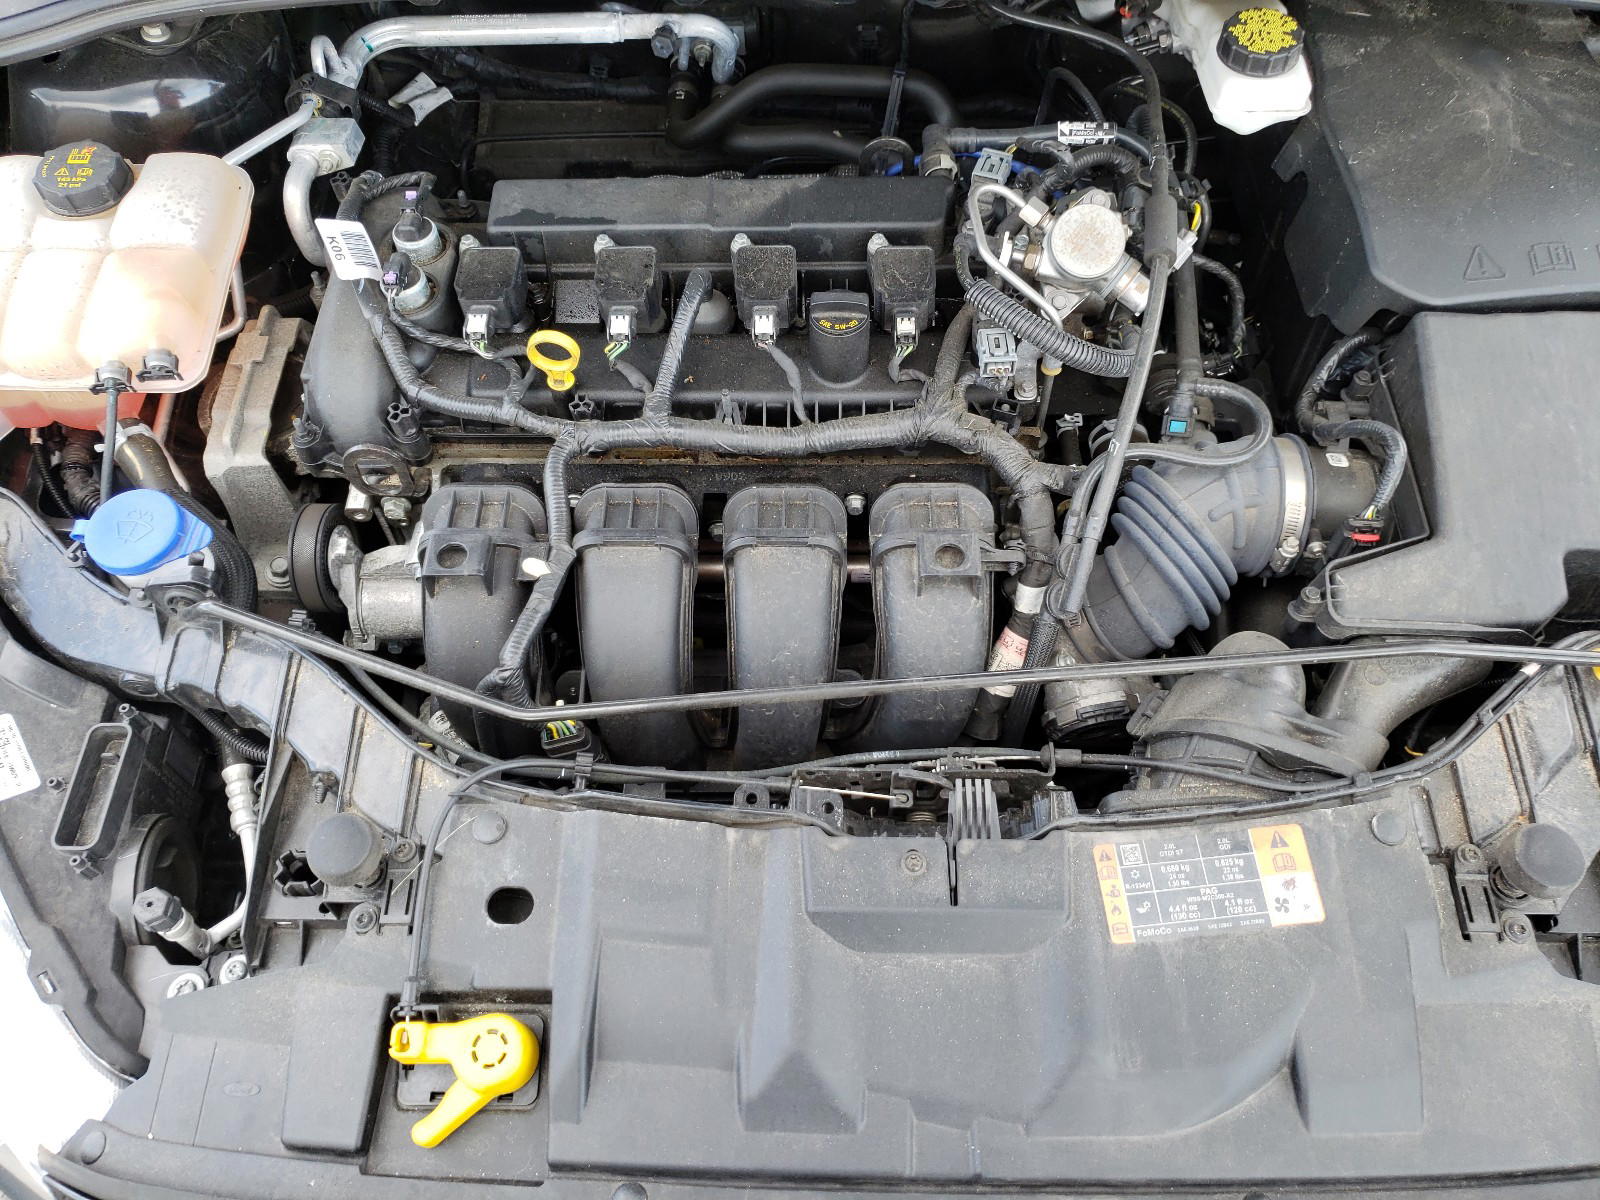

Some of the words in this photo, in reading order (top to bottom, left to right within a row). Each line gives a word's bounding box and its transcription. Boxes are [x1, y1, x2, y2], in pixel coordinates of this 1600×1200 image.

[326, 236, 346, 261] K06
[1234, 857, 1244, 866] kg
[1180, 863, 1190, 872] kg
[1200, 887, 1218, 896] PAG
[1244, 905, 1257, 913] cc)
[1188, 911, 1200, 919] cc)
[1136, 926, 1173, 937] FoMoCo
